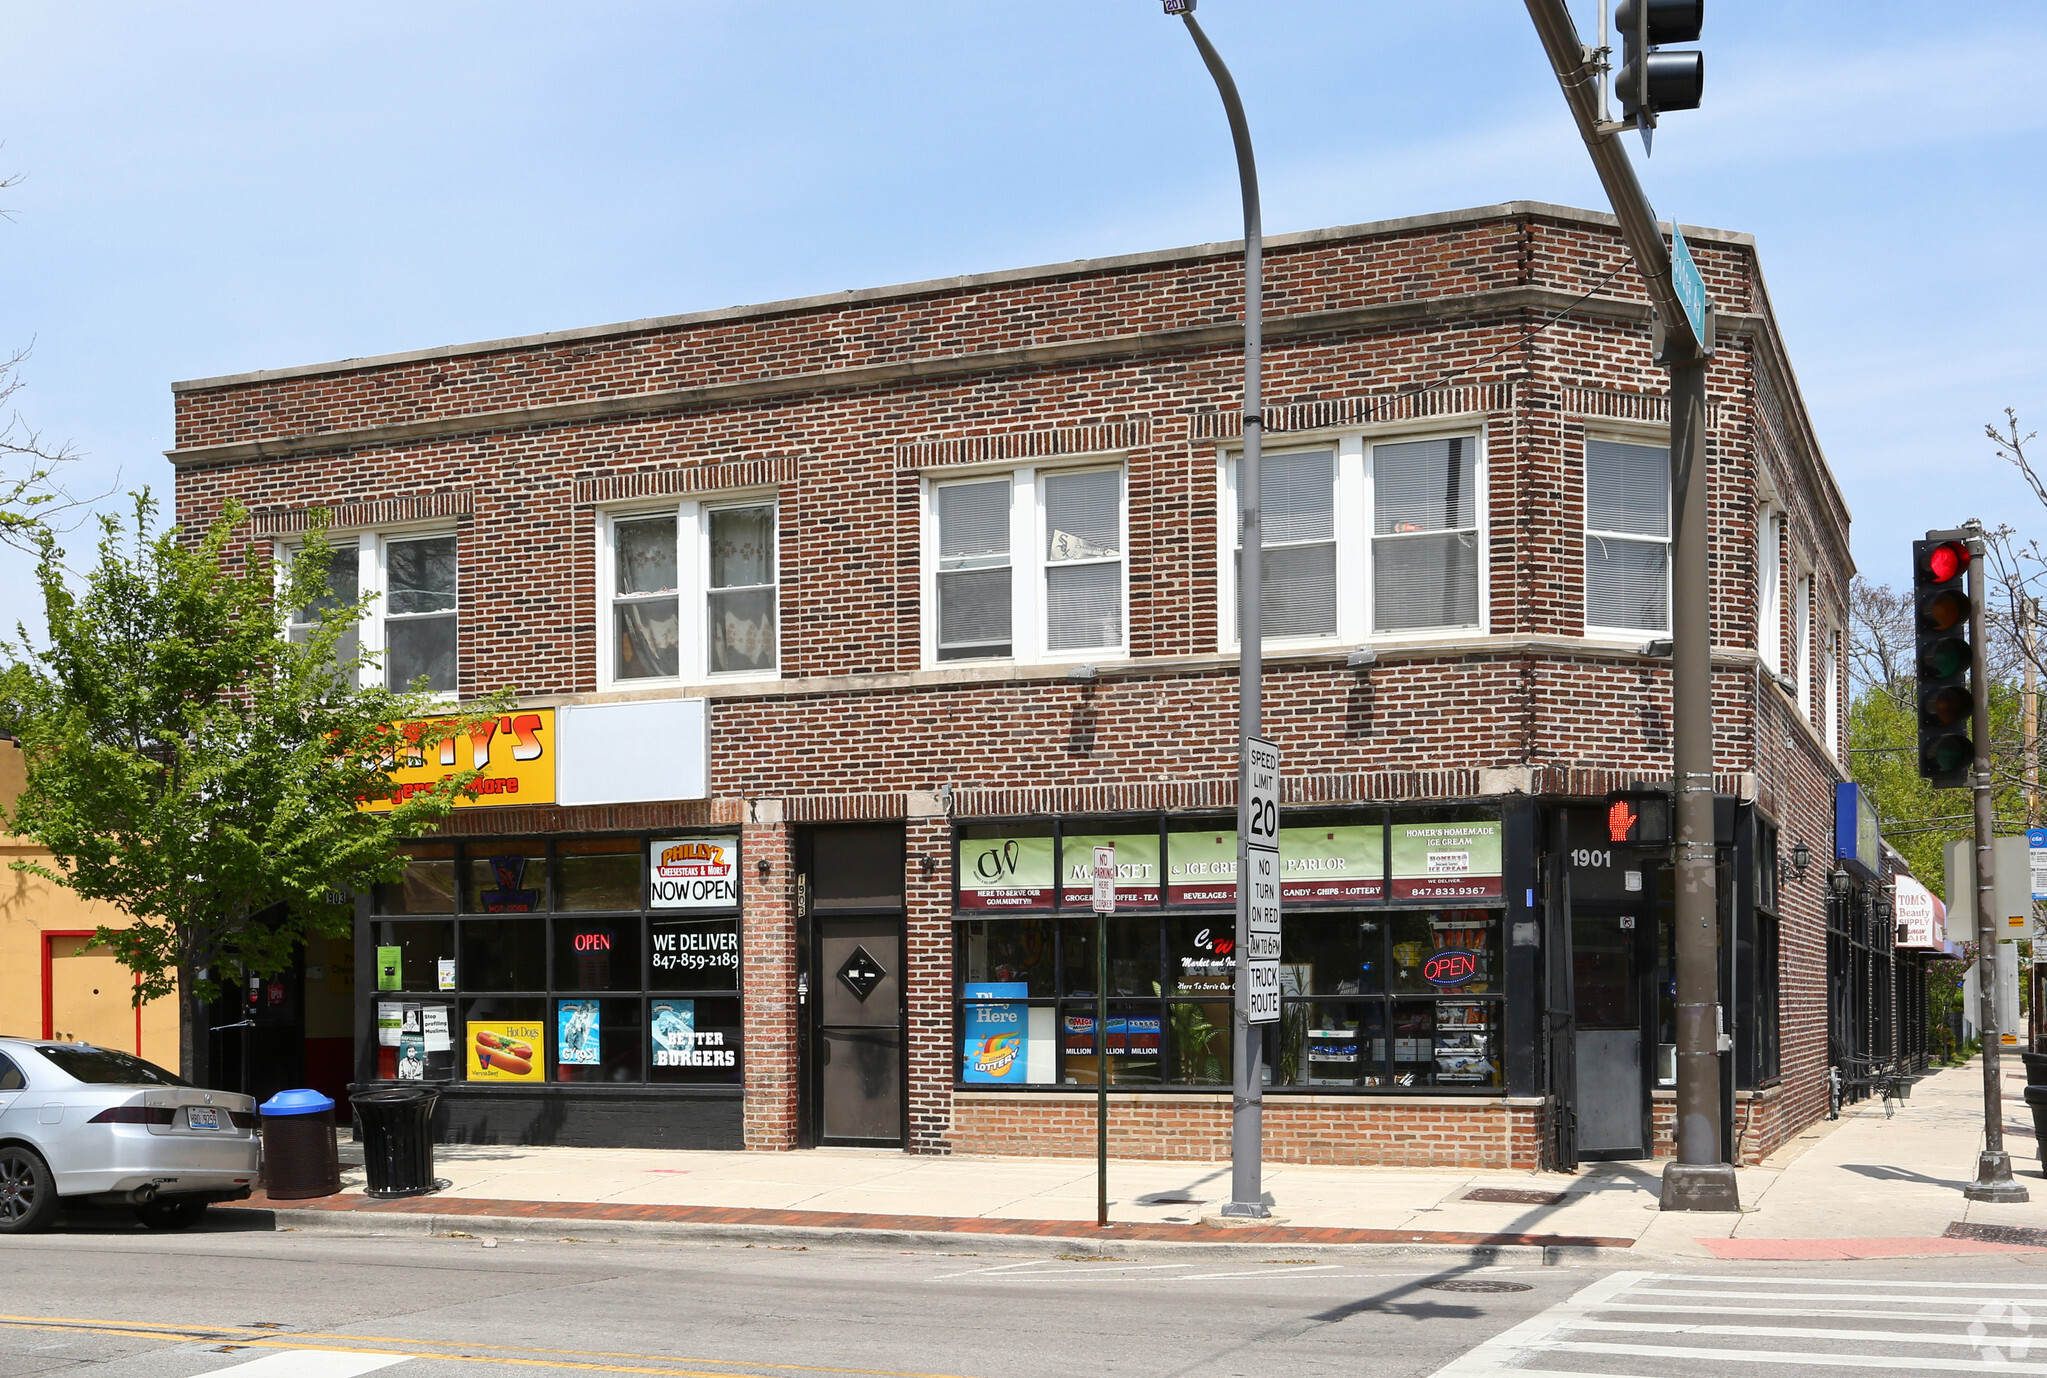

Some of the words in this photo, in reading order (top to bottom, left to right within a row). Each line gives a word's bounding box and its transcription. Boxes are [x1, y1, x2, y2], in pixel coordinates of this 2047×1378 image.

[1251, 749, 1275, 771] SPEED
[1254, 772, 1273, 791] LIMIT
[1251, 796, 1276, 838] 20
[1406, 829, 1442, 837] HOMER'S
[1443, 827, 1494, 836] HOMEMADE
[1442, 838, 1473, 846] CREAM
[1100, 854, 1108, 866] NO
[1571, 849, 1611, 868] 1901
[700, 867, 706, 876] &
[1071, 864, 1152, 879] MKET
[1172, 865, 1180, 874] &
[1185, 862, 1208, 874] ICE
[1286, 858, 1346, 871] PARLOR
[1095, 867, 1114, 879] PARKING
[1259, 859, 1271, 876] NO
[652, 881, 689, 900] NOW
[692, 880, 736, 900] OPEN
[1099, 881, 1109, 889] HERE
[1255, 883, 1274, 900] TURN
[1317, 888, 1339, 896] CHIPS
[1345, 887, 1381, 895] LOTTERY
[1411, 887, 1486, 896] 847.833.9367
[1101, 890, 1107, 898] TO
[1183, 892, 1227, 900] BEVERAGES
[1096, 899, 1113, 908] CORNER
[1252, 907, 1262, 922] ON
[1264, 908, 1278, 924] RED
[1898, 908, 1930, 918] Beauty
[574, 934, 610, 951] OPEN
[653, 934, 676, 951] WE
[680, 933, 738, 951] DELIVER
[1194, 928, 1210, 947] C
[1205, 941, 1213, 950] &
[1213, 938, 1234, 954] W
[1261, 937, 1268, 953] TO
[652, 952, 739, 970] 847-859-2189
[1181, 957, 1210, 967] Market
[1210, 957, 1224, 967] and
[1424, 955, 1476, 979] OPEN
[1177, 981, 1192, 990] Here
[1193, 982, 1201, 990] To
[1202, 982, 1218, 990] Serve
[1251, 967, 1278, 988] TRUCK
[1251, 993, 1278, 1013] ROUTE
[976, 1008, 1018, 1023] Here
[425, 1020, 447, 1028] profiling
[506, 1026, 519, 1037] Hot
[520, 1026, 539, 1040] Dogs
[668, 1032, 724, 1046] BETTER
[657, 1050, 735, 1067] BURGERS
[974, 1046, 1020, 1072] LOTTERY
